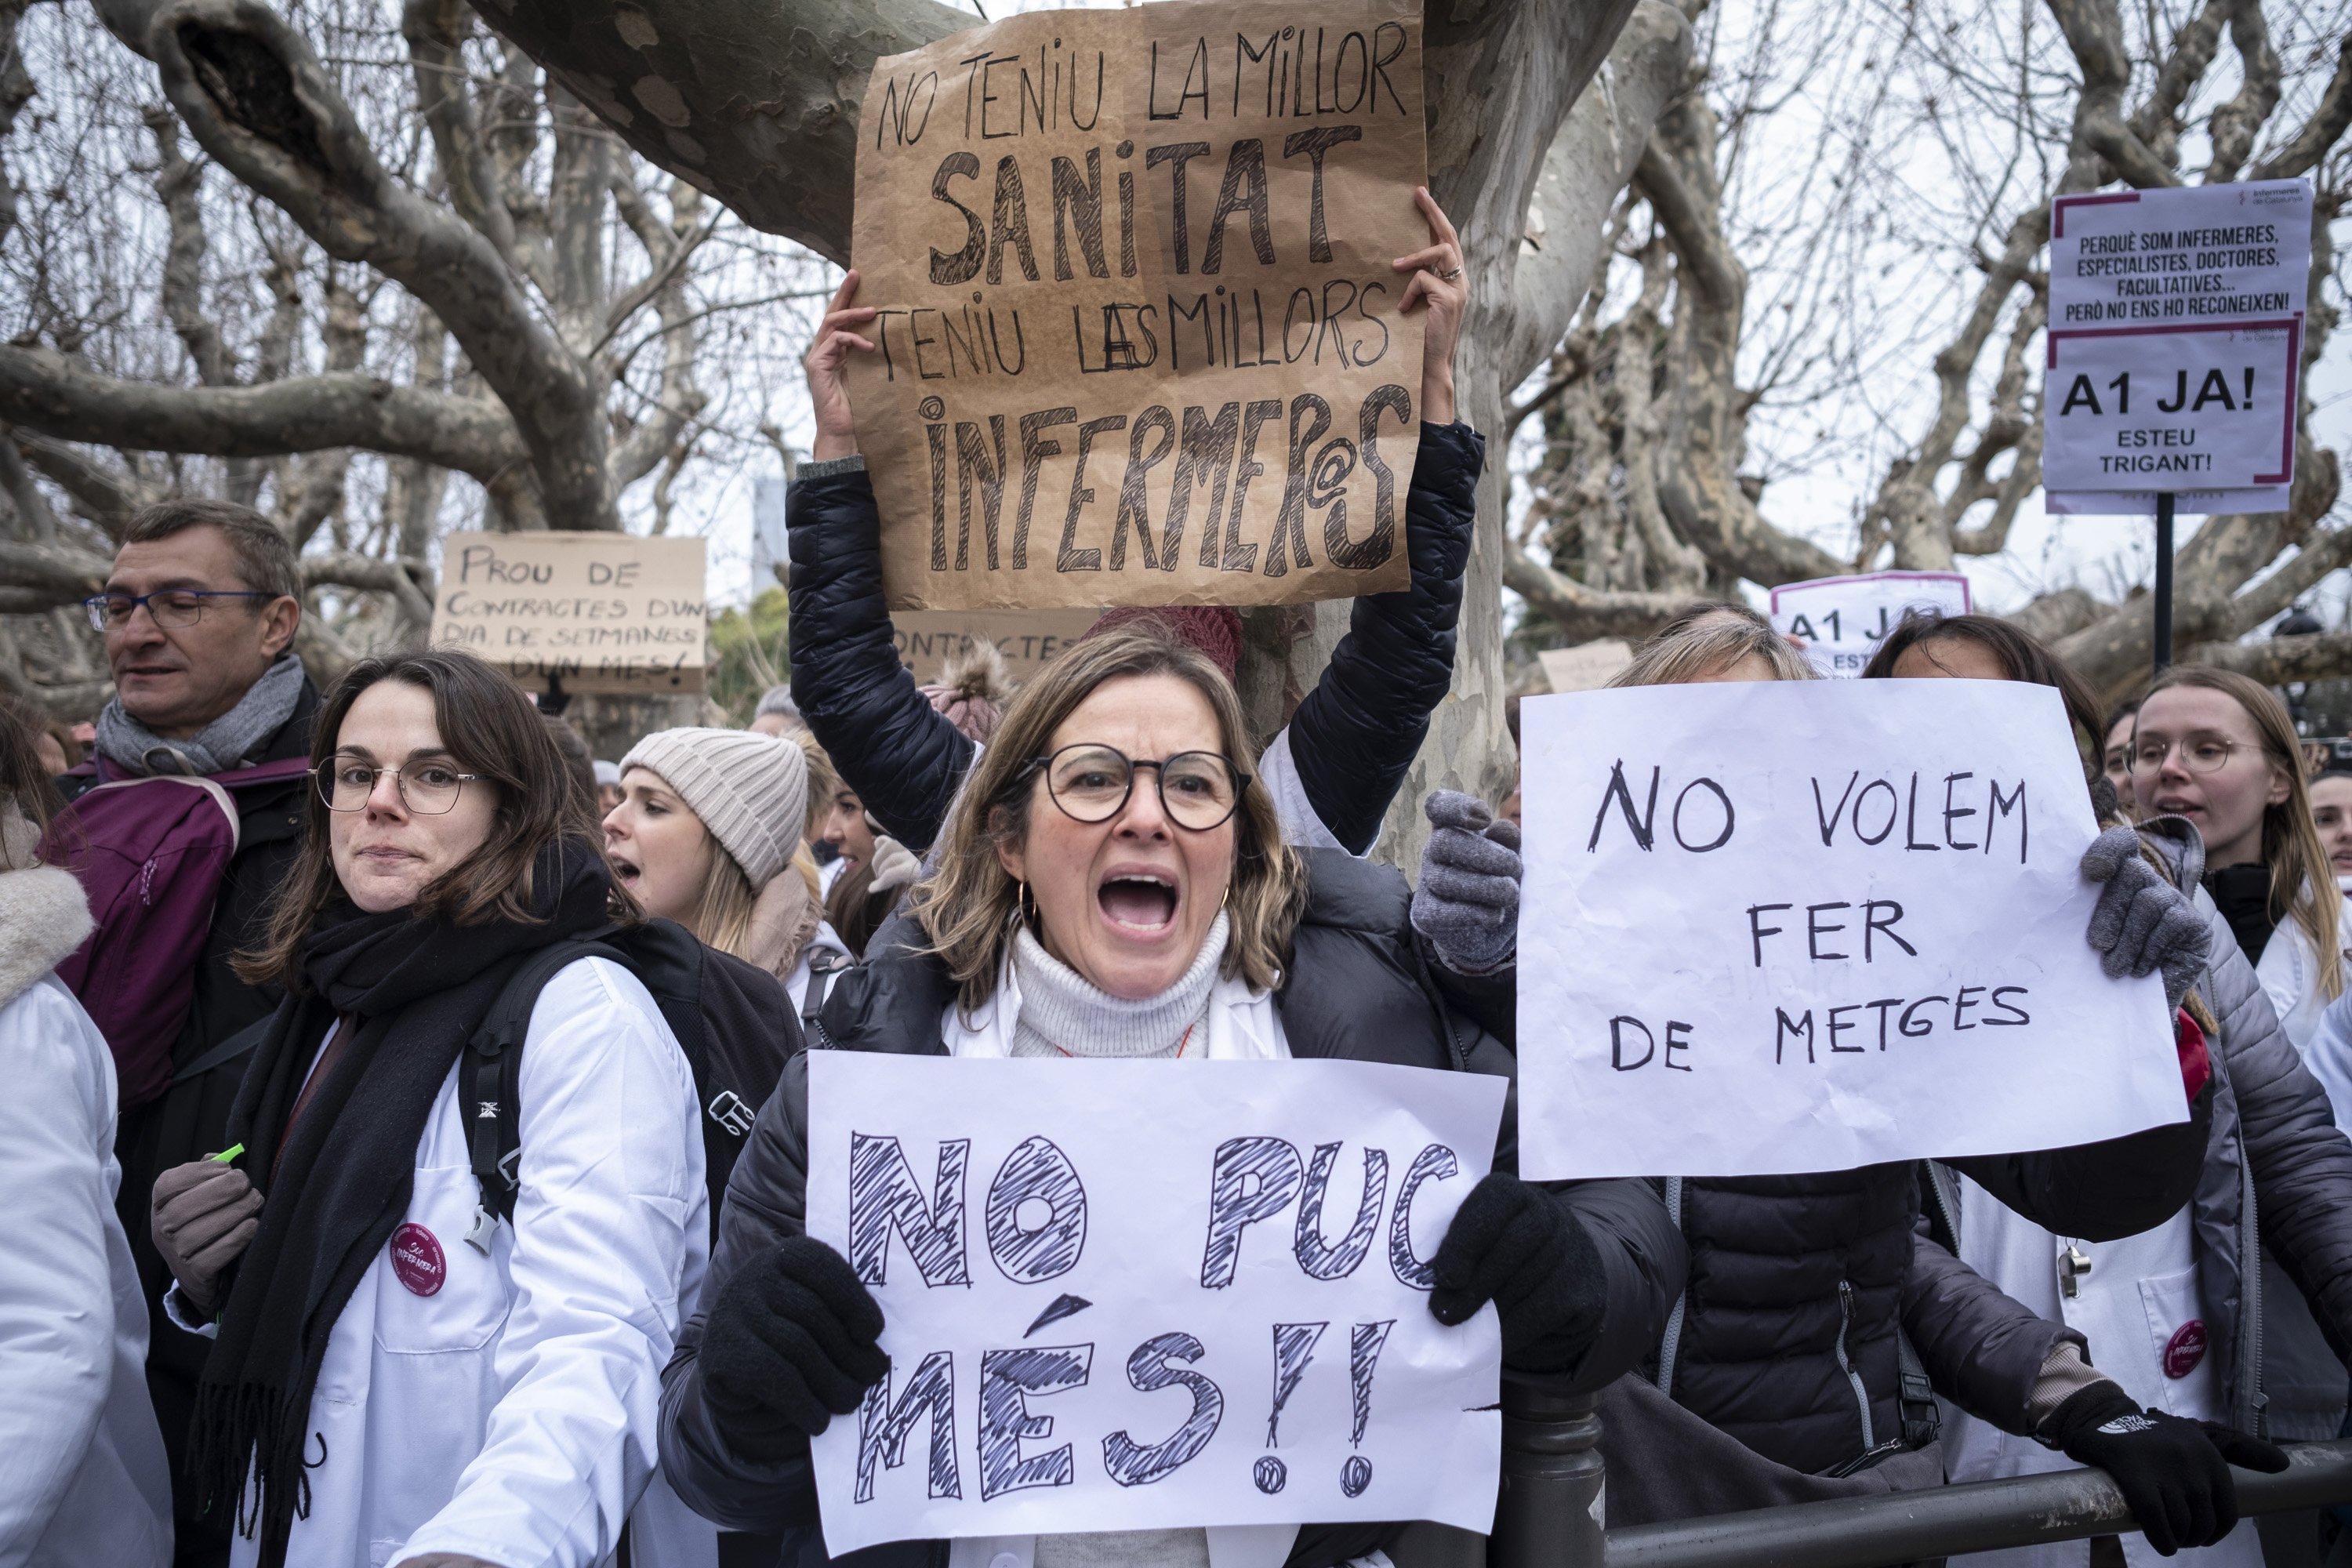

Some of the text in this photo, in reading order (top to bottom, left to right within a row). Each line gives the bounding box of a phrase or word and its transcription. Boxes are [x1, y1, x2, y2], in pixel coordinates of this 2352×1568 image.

[877, 71, 938, 150] NO
[1149, 37, 1209, 121] LA
[2080, 224, 2278, 254] PERQUÈ SOM INFERMERES,
[2078, 248, 2280, 276] ESPECIALISTES, DOCTORES,
[2118, 274, 2235, 296] FACULTATIVES...
[2066, 292, 2289, 321] PERÒ NO ENS HO RECONEIXEN!
[2060, 367, 2255, 416] A1 JA!
[2118, 428, 2196, 448] ESTEU
[2100, 454, 2212, 474] TRIGANT!
[460, 544, 641, 588] PROU DE
[445, 590, 629, 619] CONTRACTES
[506, 626, 539, 647] DE
[1789, 608, 1842, 642] A1
[1588, 758, 1735, 853] NO
[1811, 771, 2027, 865] VOLEM
[1746, 899, 1918, 967] FER
[1610, 985, 2031, 1073] DE METGES
[850, 1131, 1459, 1291] NO PUC
[397, 1247, 437, 1276] INFERMERA
[408, 1242, 424, 1258] Soc
